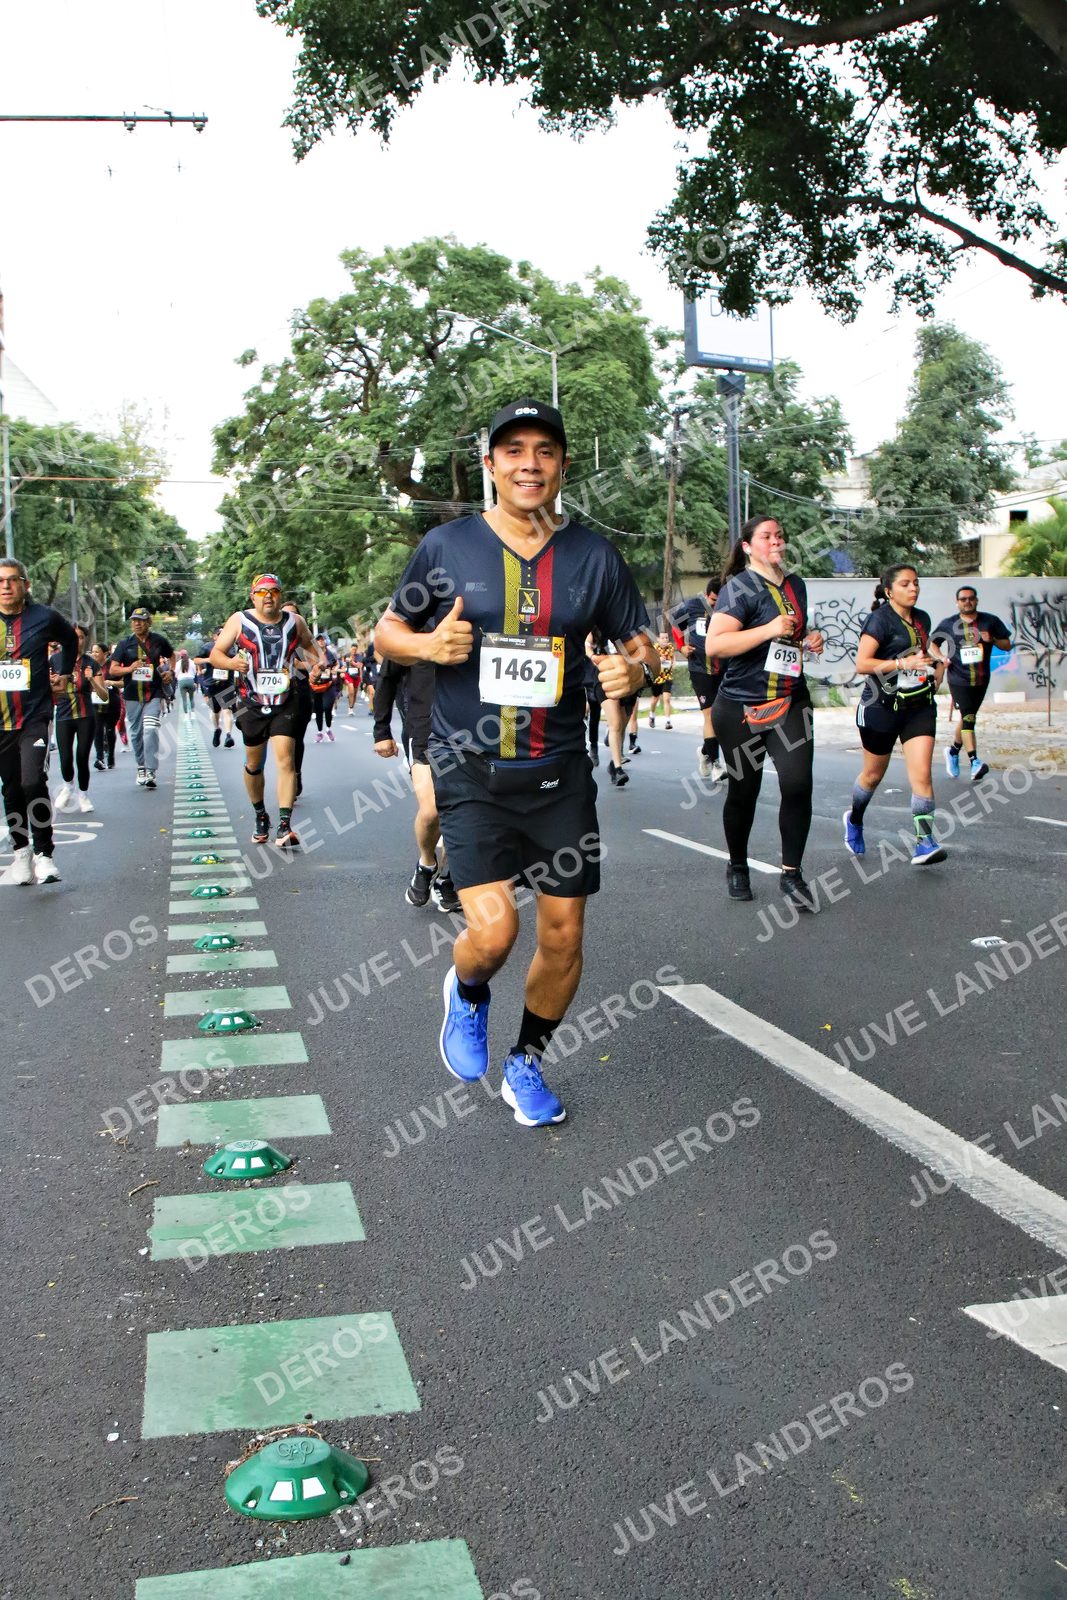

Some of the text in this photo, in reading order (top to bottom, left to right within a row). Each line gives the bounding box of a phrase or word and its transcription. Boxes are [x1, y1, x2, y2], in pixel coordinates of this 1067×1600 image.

[774, 649, 797, 663] 6159
[491, 656, 547, 682] 1462
[261, 676, 282, 686] 7704
